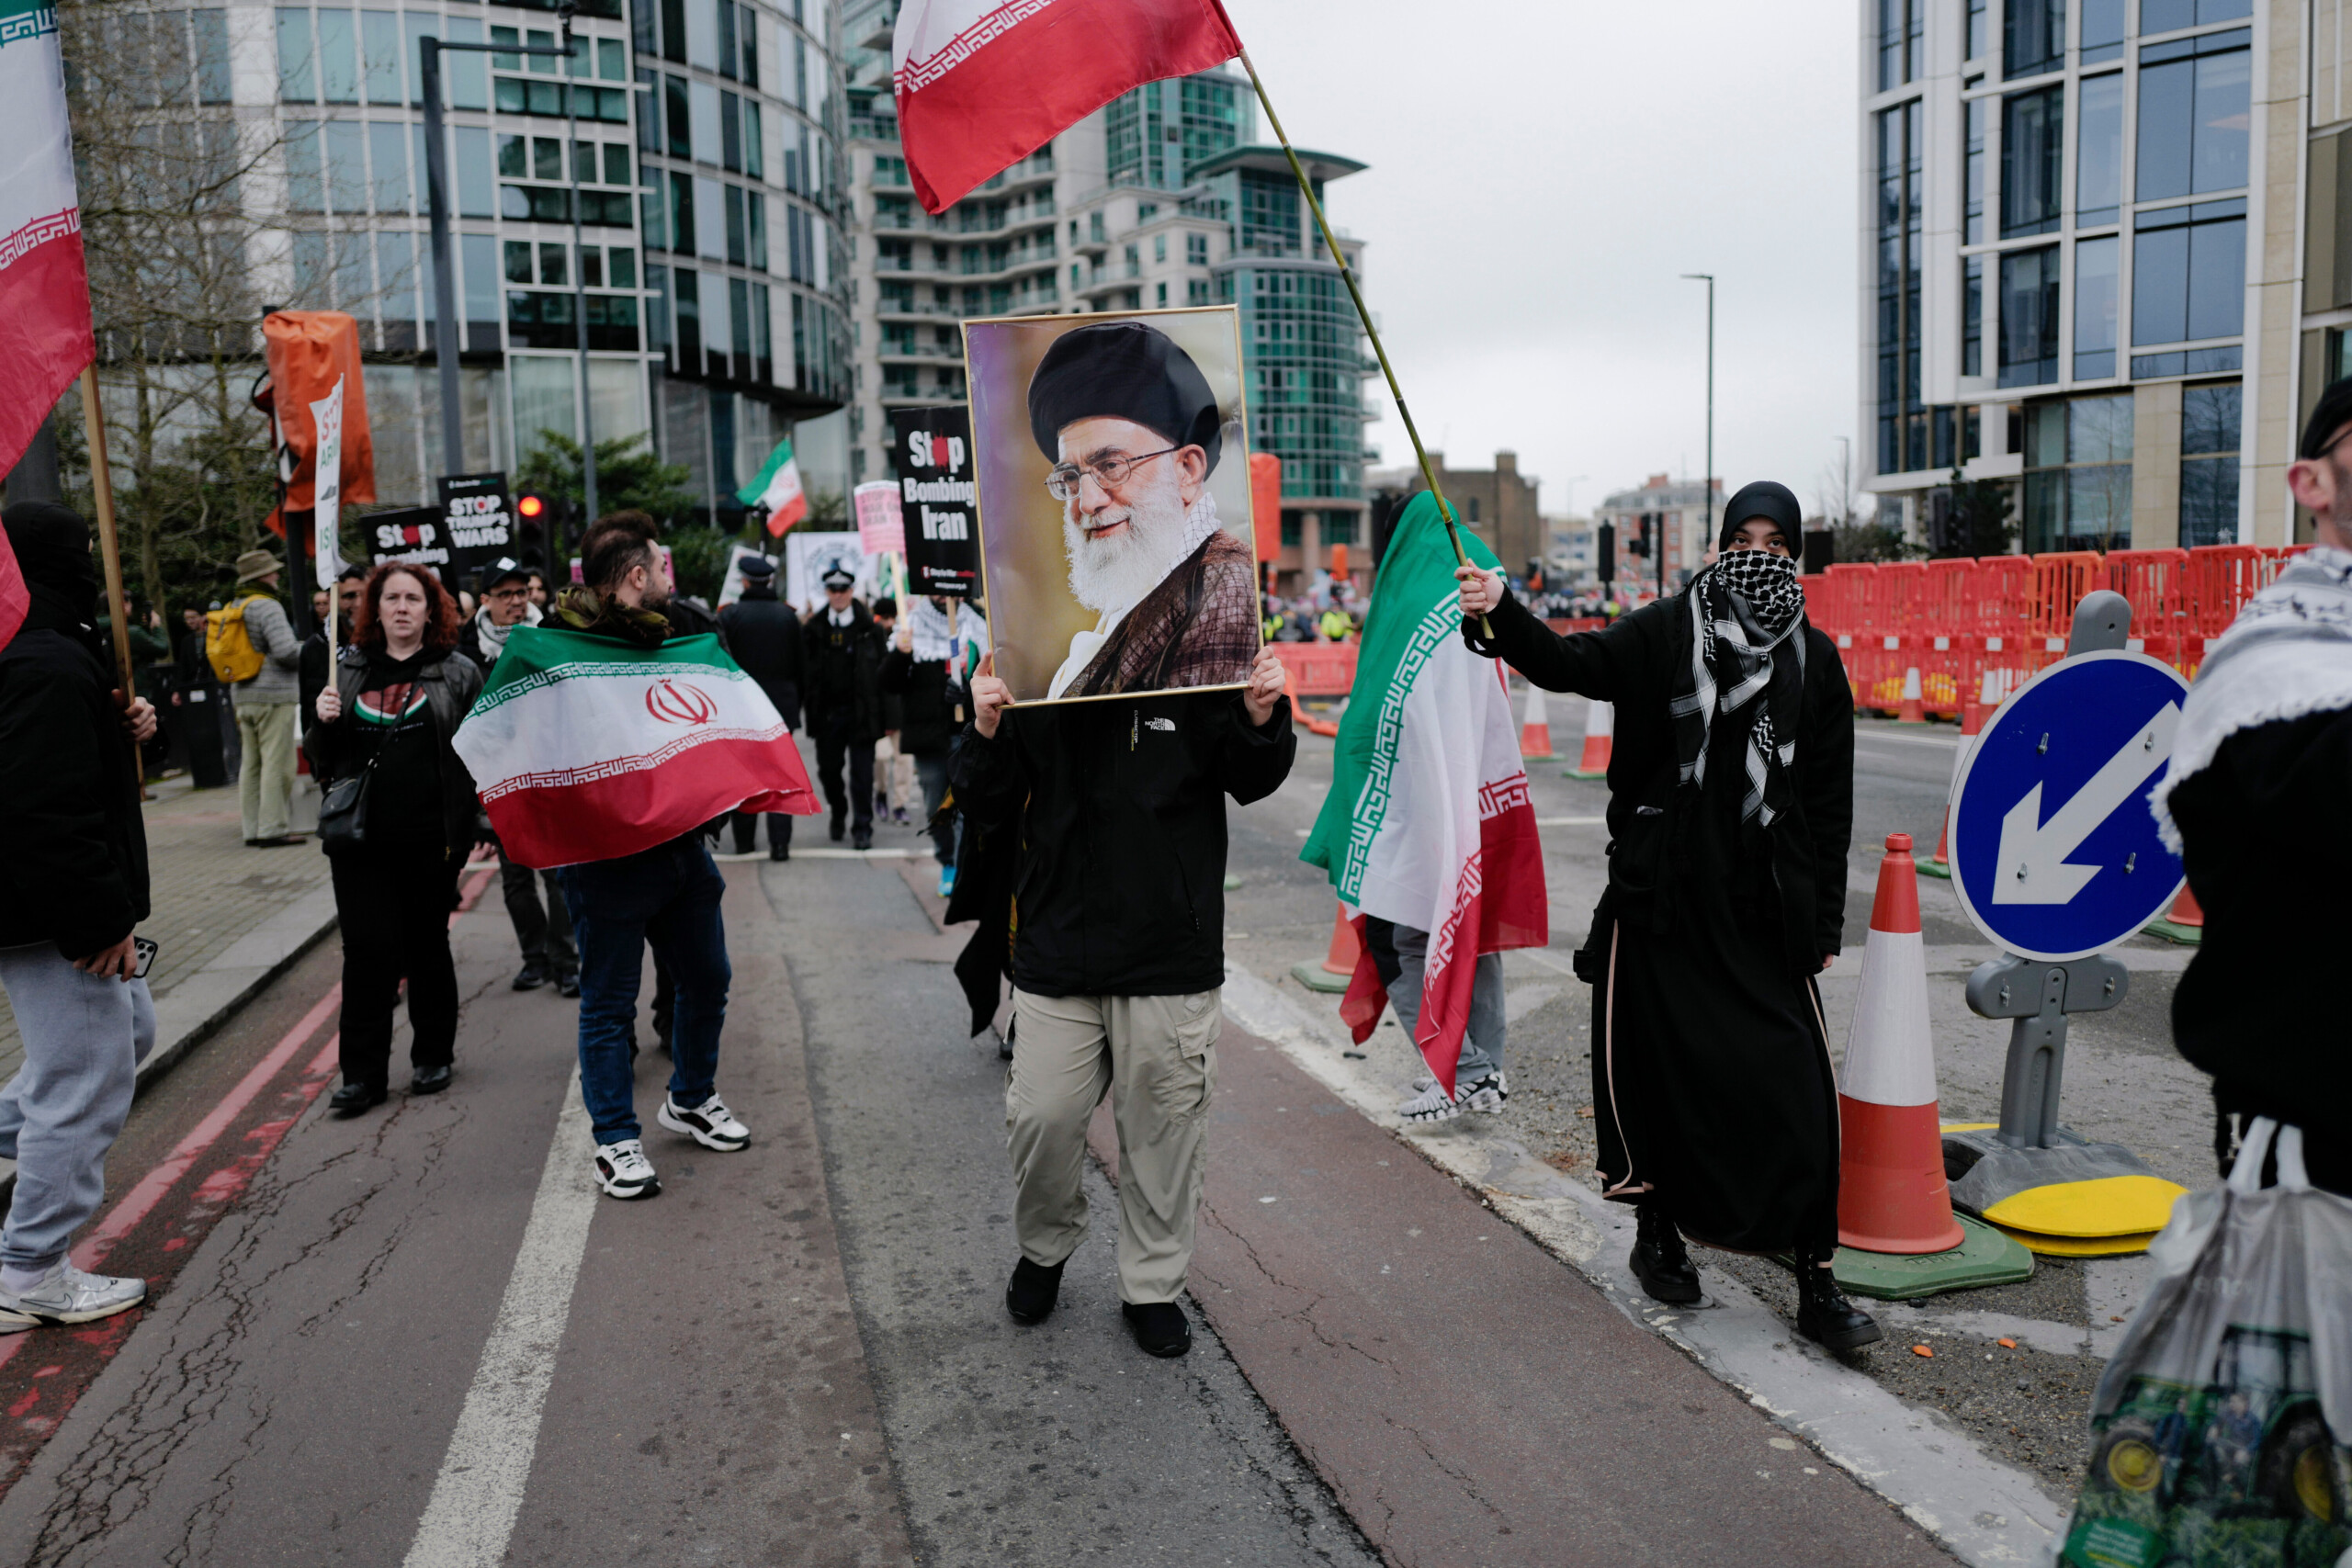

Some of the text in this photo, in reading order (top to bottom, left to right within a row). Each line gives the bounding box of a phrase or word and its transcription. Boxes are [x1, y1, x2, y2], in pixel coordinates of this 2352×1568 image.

[903, 476, 976, 507] Bombing
[449, 494, 502, 516] STOP
[445, 511, 510, 531] TRUMP'S
[921, 504, 968, 540] Iran
[450, 525, 509, 548] WARS
